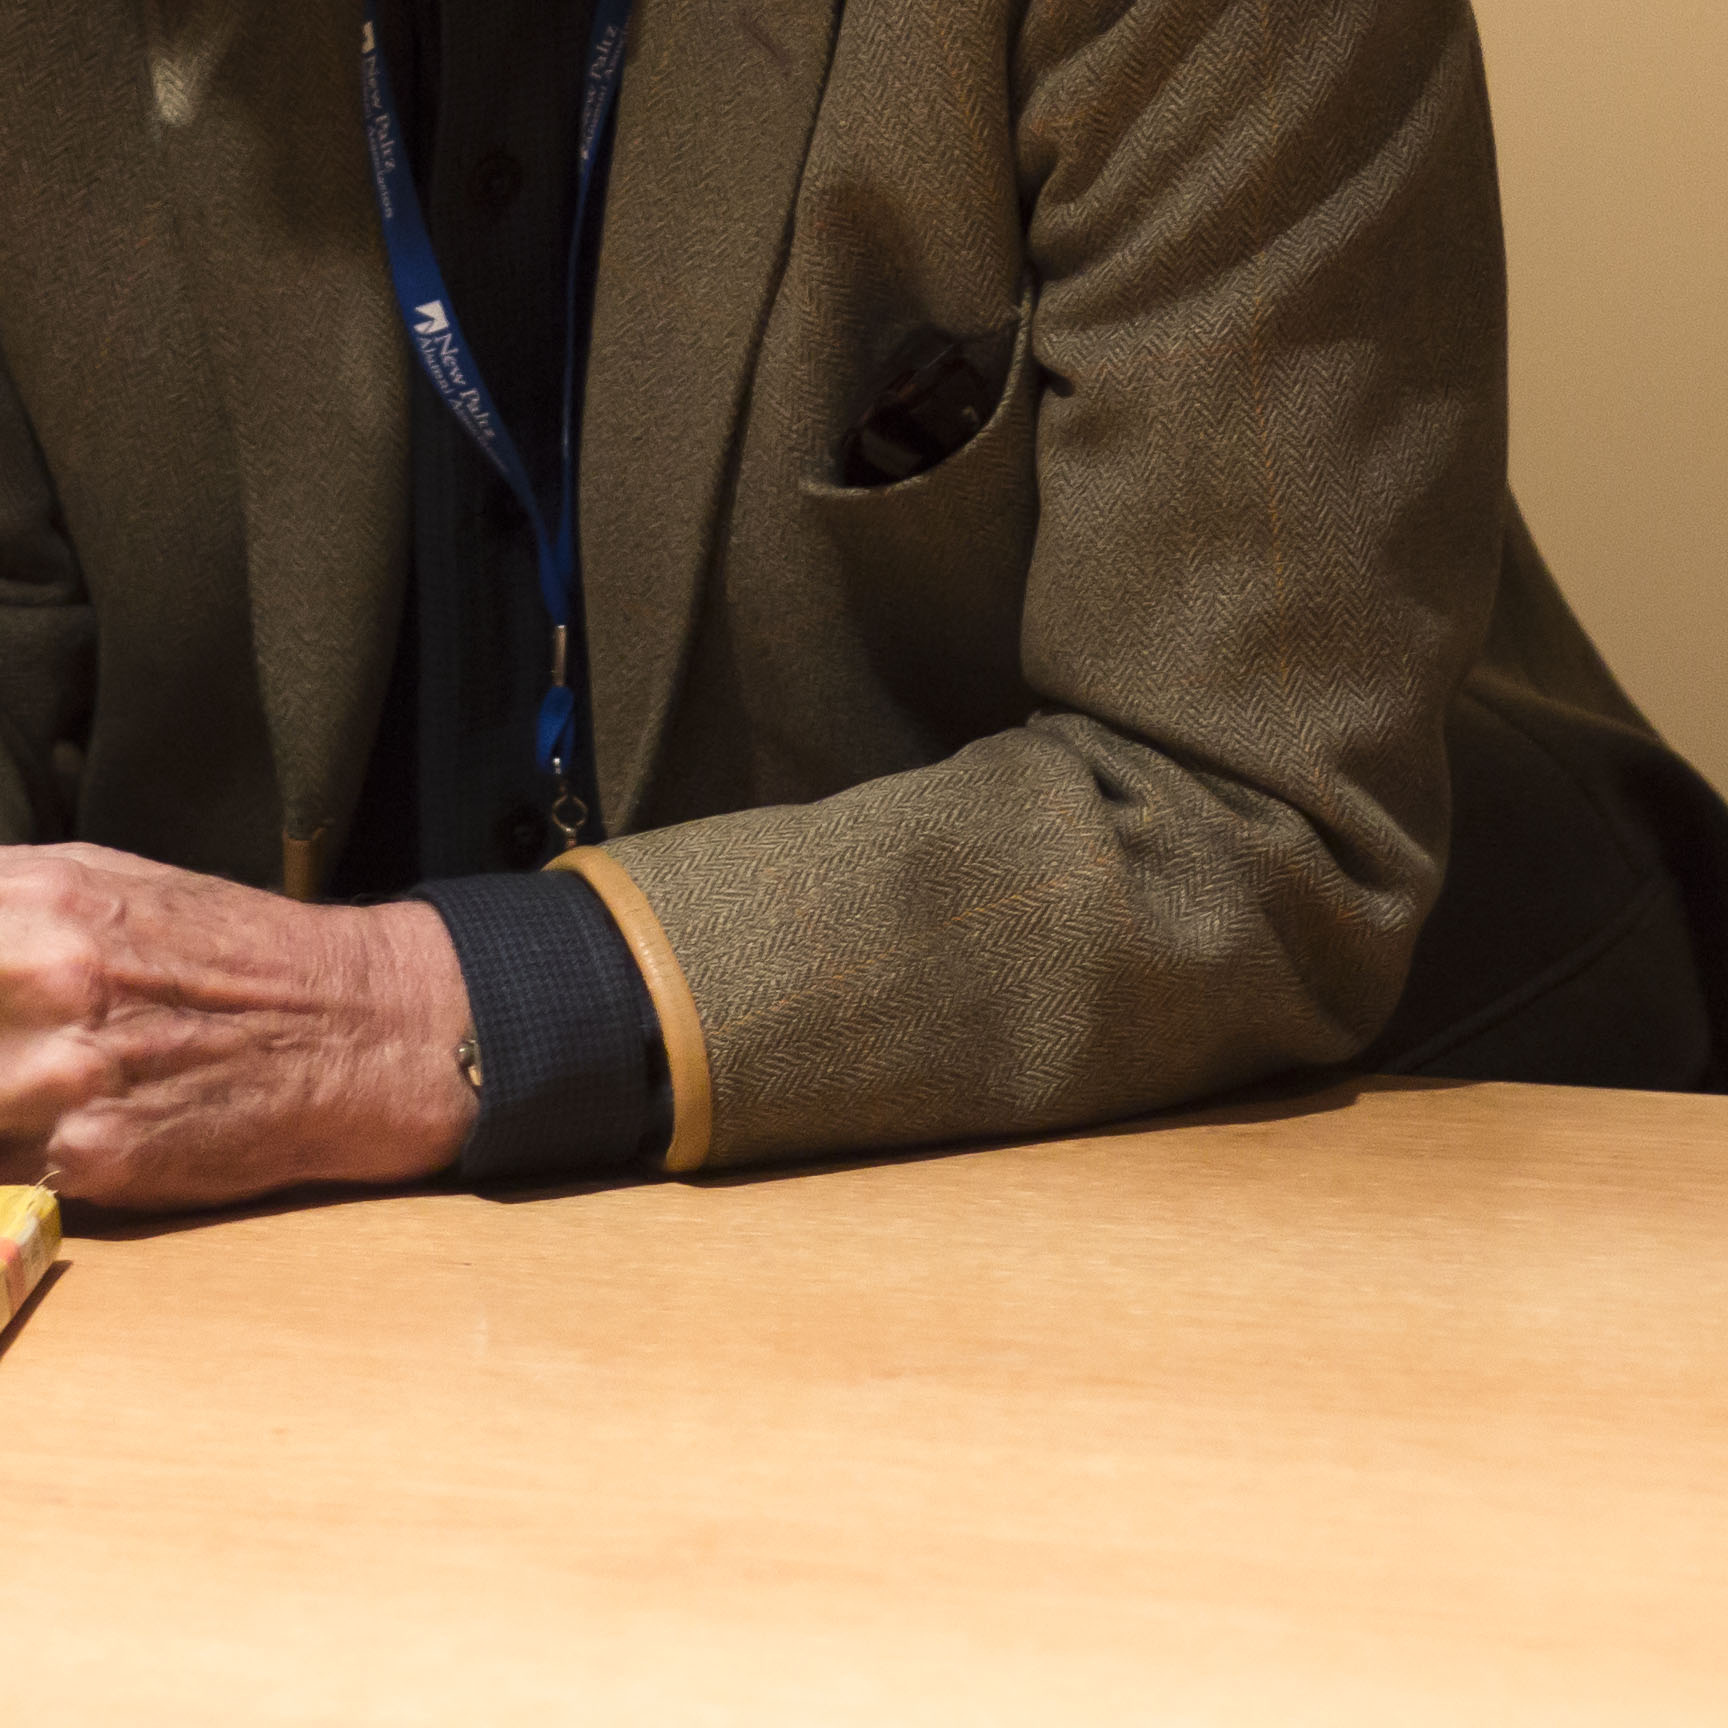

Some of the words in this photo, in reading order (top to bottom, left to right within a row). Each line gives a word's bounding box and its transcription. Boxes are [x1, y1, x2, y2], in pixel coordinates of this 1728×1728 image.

[418, 337, 455, 394] Alumni
[432, 333, 466, 386] New
[459, 388, 496, 438] Paltz
